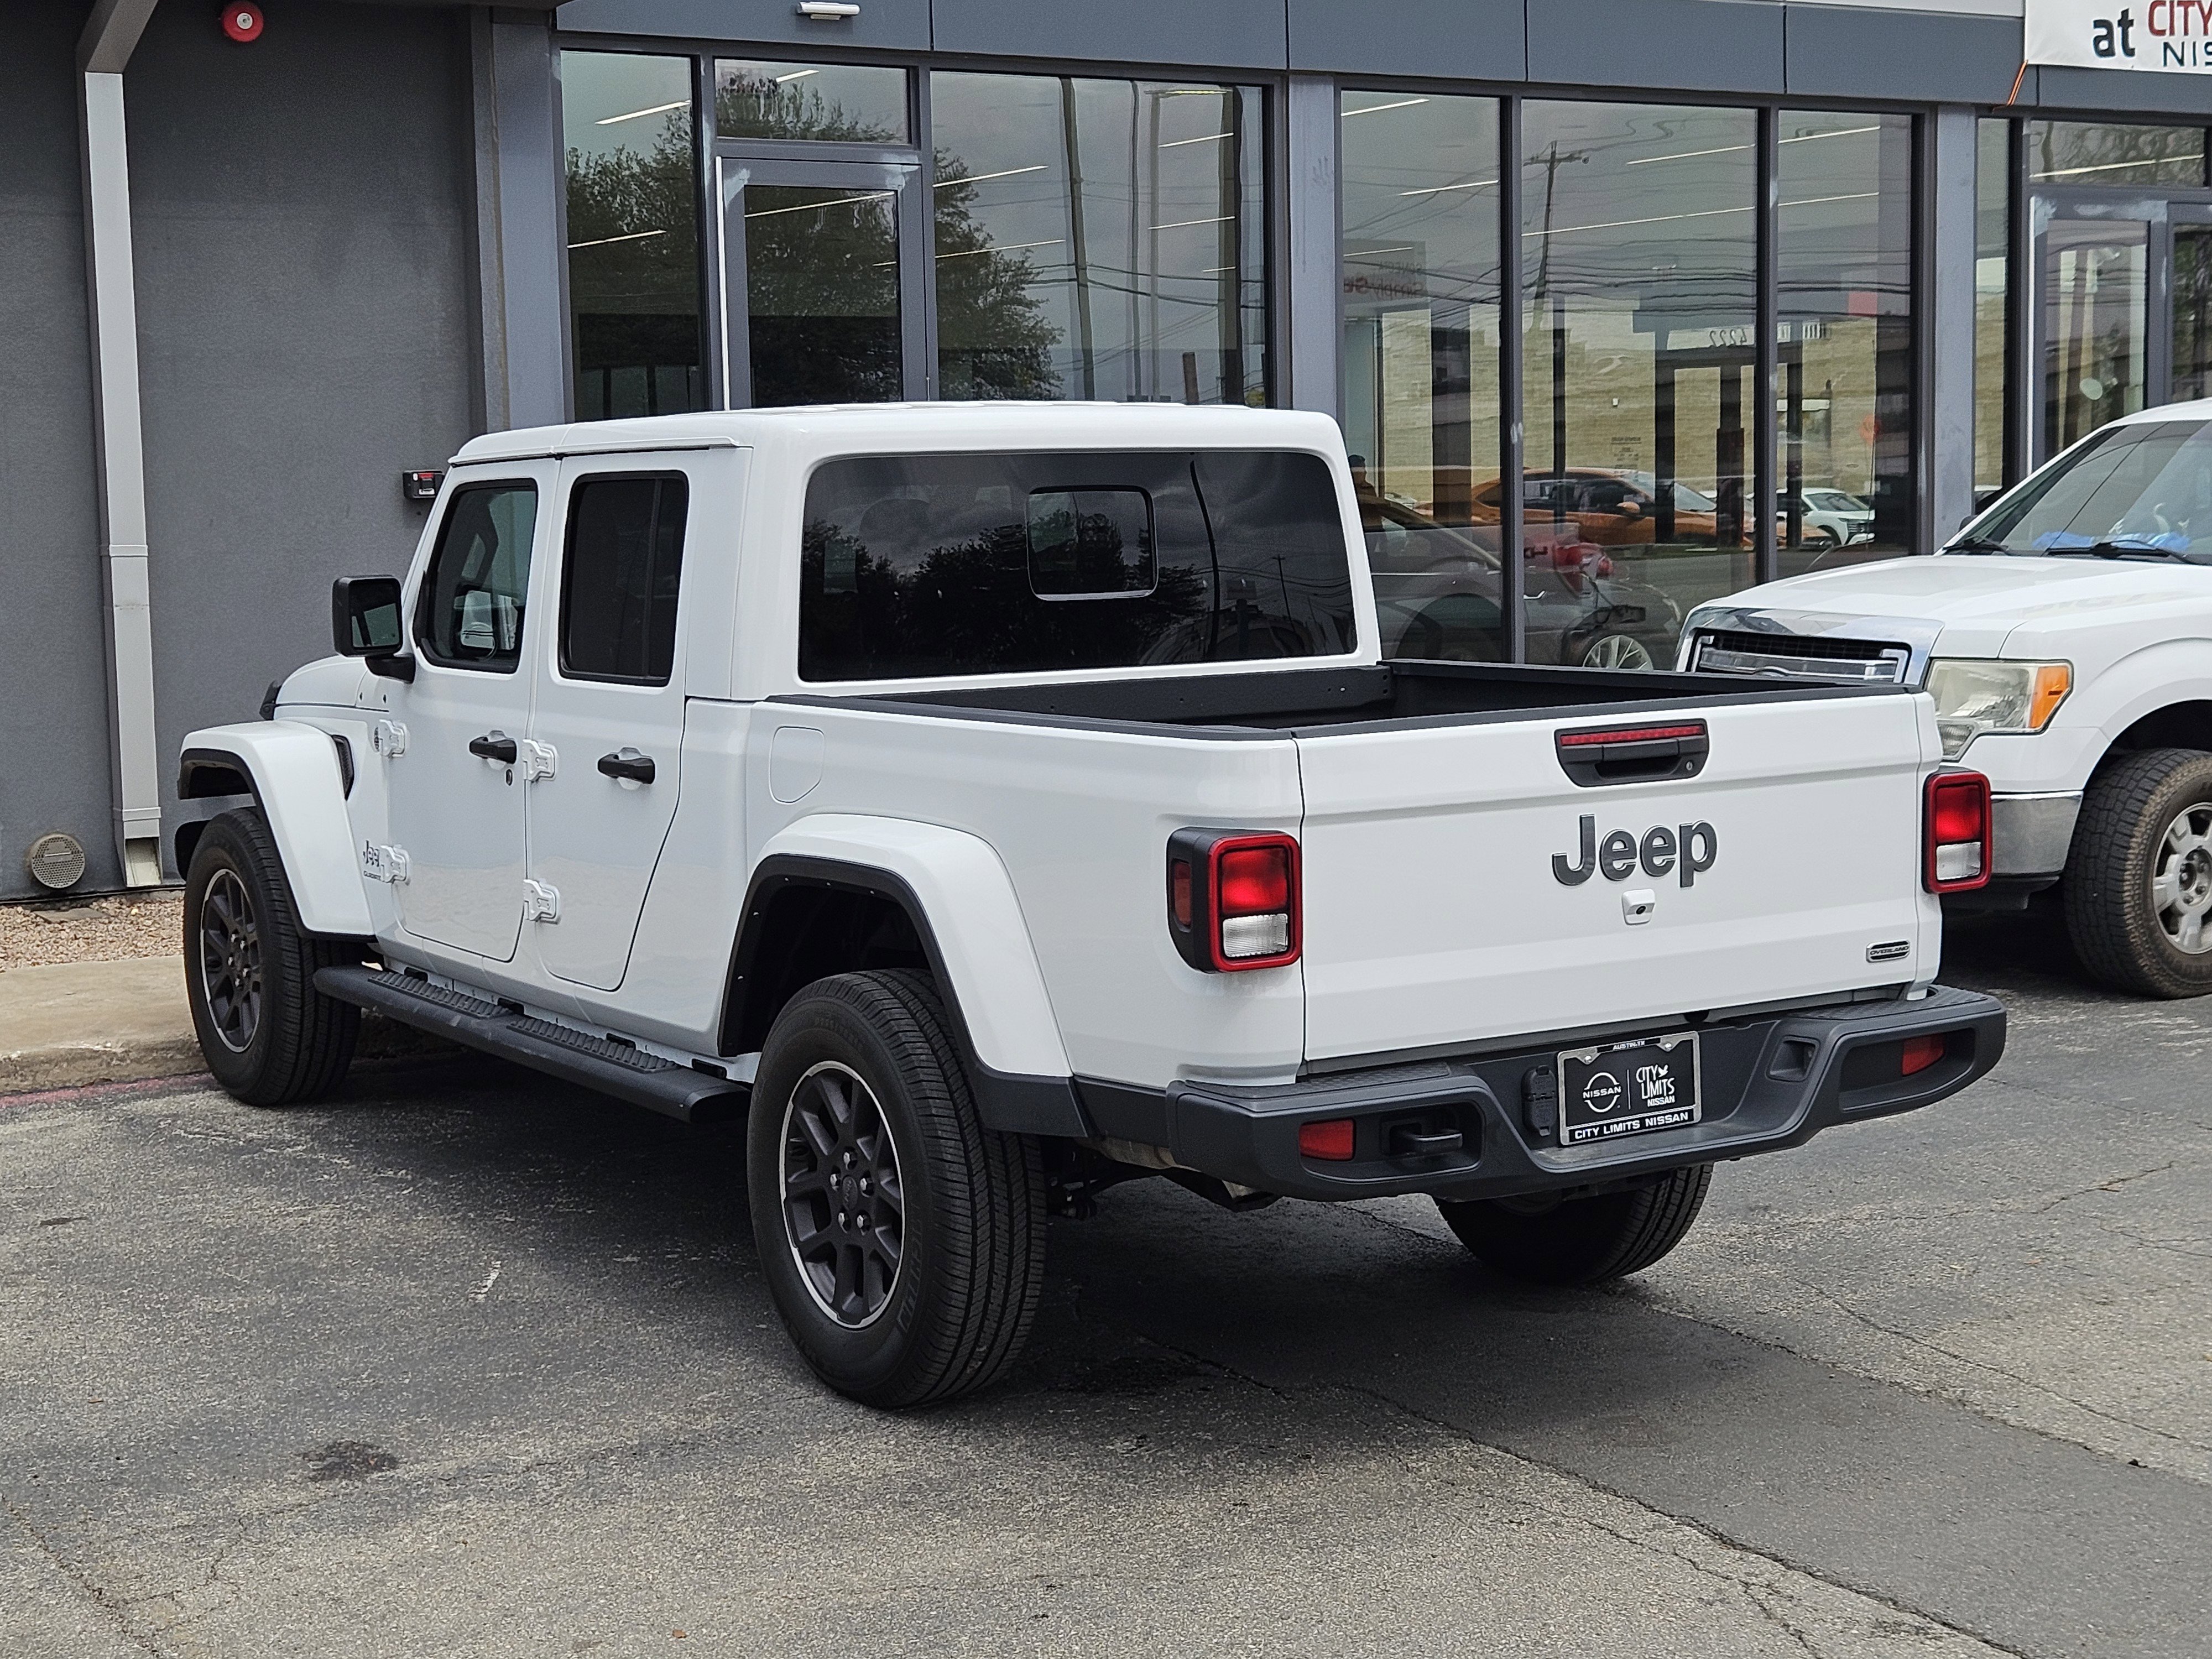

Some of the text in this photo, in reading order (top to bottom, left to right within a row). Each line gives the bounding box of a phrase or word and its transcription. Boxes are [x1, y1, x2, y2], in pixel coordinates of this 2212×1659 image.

[2093, 0, 2212, 58] at CITY
[1551, 813, 1718, 888] Jeep
[1870, 946, 1910, 955] OVERLAND
[1636, 1064, 1658, 1083] CITY
[1583, 1086, 1621, 1099] NISSAN
[1641, 1077, 1675, 1099] LIMITS
[1647, 1095, 1675, 1107] NISSAN
[1574, 1112, 1688, 1140] CITY LIMITS NISSAN
